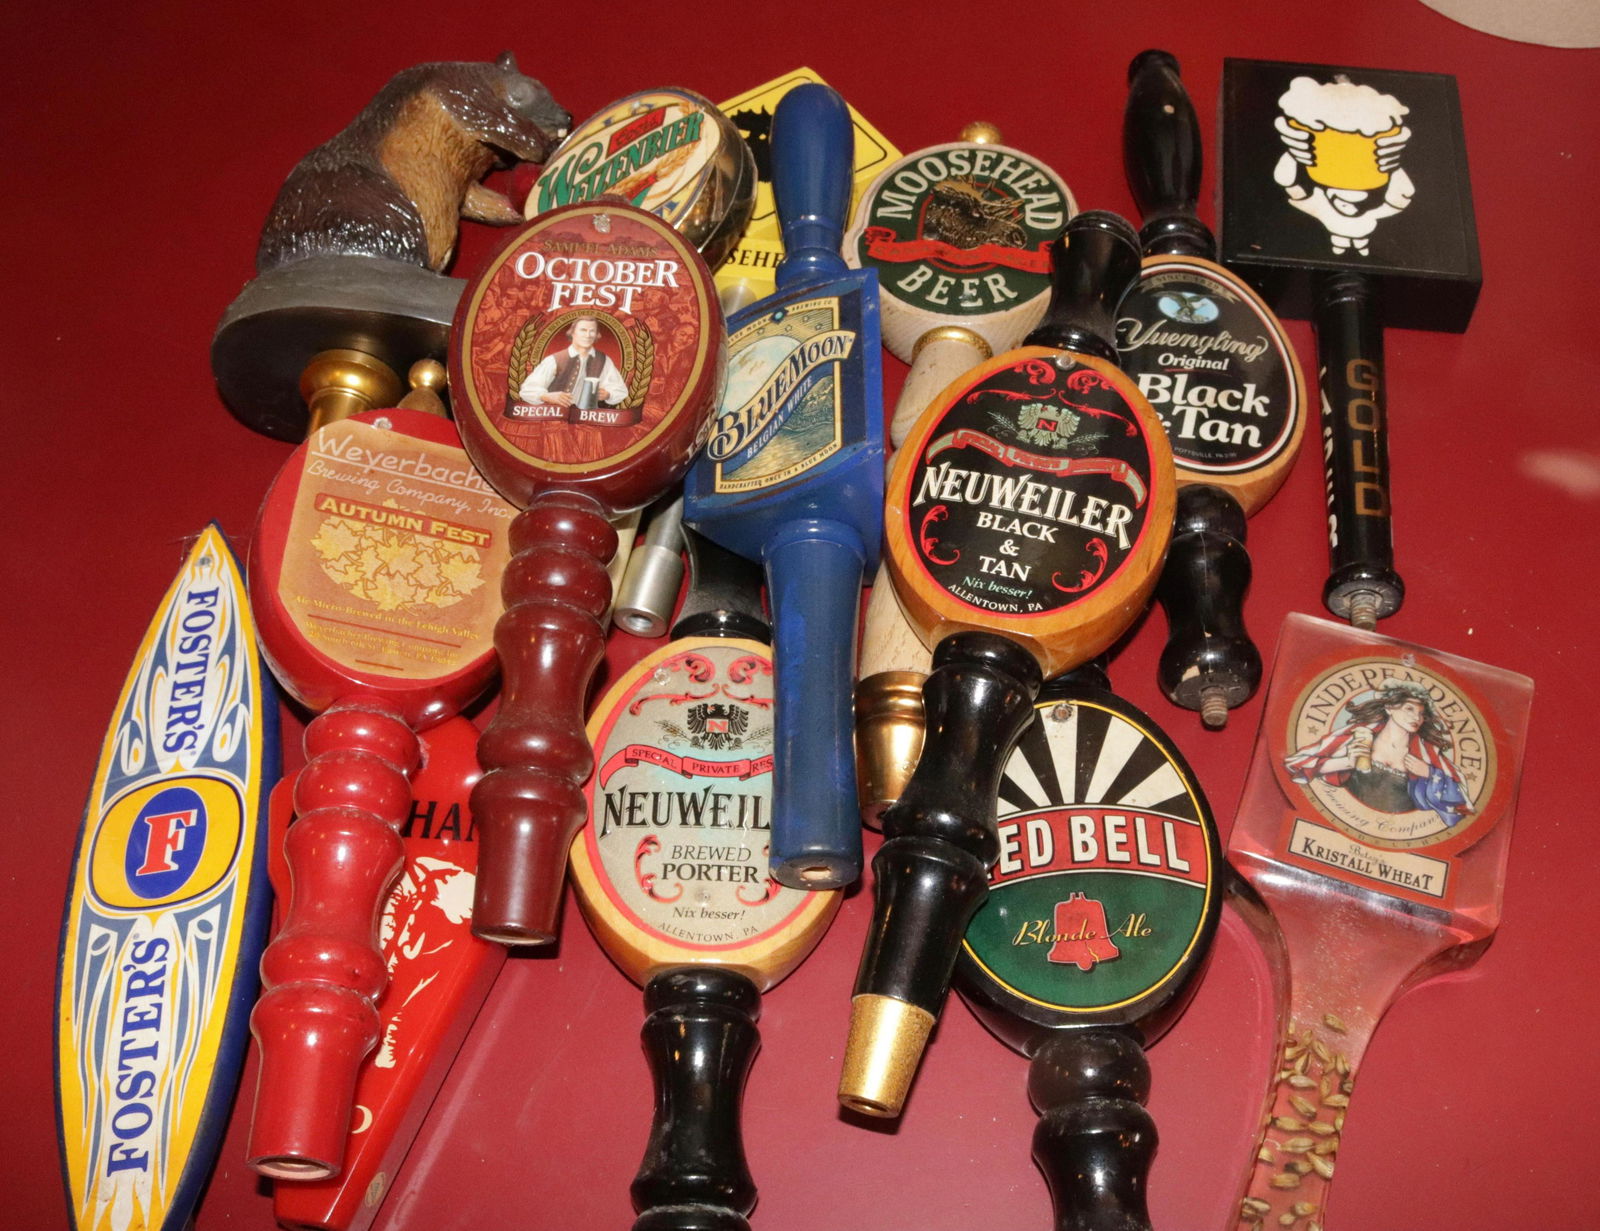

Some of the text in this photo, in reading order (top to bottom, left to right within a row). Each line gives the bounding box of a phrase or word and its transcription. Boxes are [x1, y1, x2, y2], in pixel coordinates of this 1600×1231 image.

[876, 150, 1063, 230] MOOSEHEAD
[515, 252, 679, 288] OCTOBER
[897, 264, 1018, 307] BEER
[547, 282, 641, 315] FEST
[1116, 318, 1269, 362] Yuengling
[1158, 353, 1229, 371] Original
[512, 405, 619, 423] SPECIAL BREW
[707, 365, 788, 461] BLUE
[787, 336, 847, 388] MOON
[1138, 373, 1270, 417] Black
[747, 376, 812, 458] BELGIAN WHITE
[1172, 406, 1262, 448] Tan
[1346, 359, 1387, 516] GOLD
[318, 427, 493, 493] Weyerbache
[307, 460, 512, 519] Brewing Company, Inc.
[912, 461, 1133, 550] NEUWEILER
[320, 497, 490, 546] AUTUMN FEST
[976, 511, 1059, 543] BLACK
[999, 539, 1019, 556] &
[962, 576, 1033, 599] Nix besser!
[979, 556, 1032, 582] TAN
[1027, 602, 1043, 612] PA
[163, 587, 220, 754] FOSTER'S
[632, 749, 773, 774] SPECIAL PRIVATE RES
[599, 784, 770, 839] NEUWEIL
[672, 845, 752, 862] BREWED
[987, 815, 1190, 879] ED BELL
[1303, 837, 1433, 891] KRISTALL WHEAT
[661, 863, 759, 884] PORTER
[672, 906, 746, 920] Nix besser!
[743, 925, 759, 936] PA
[1012, 913, 1152, 946] Blonde Ale
[106, 936, 170, 1177] FOSTER'S
